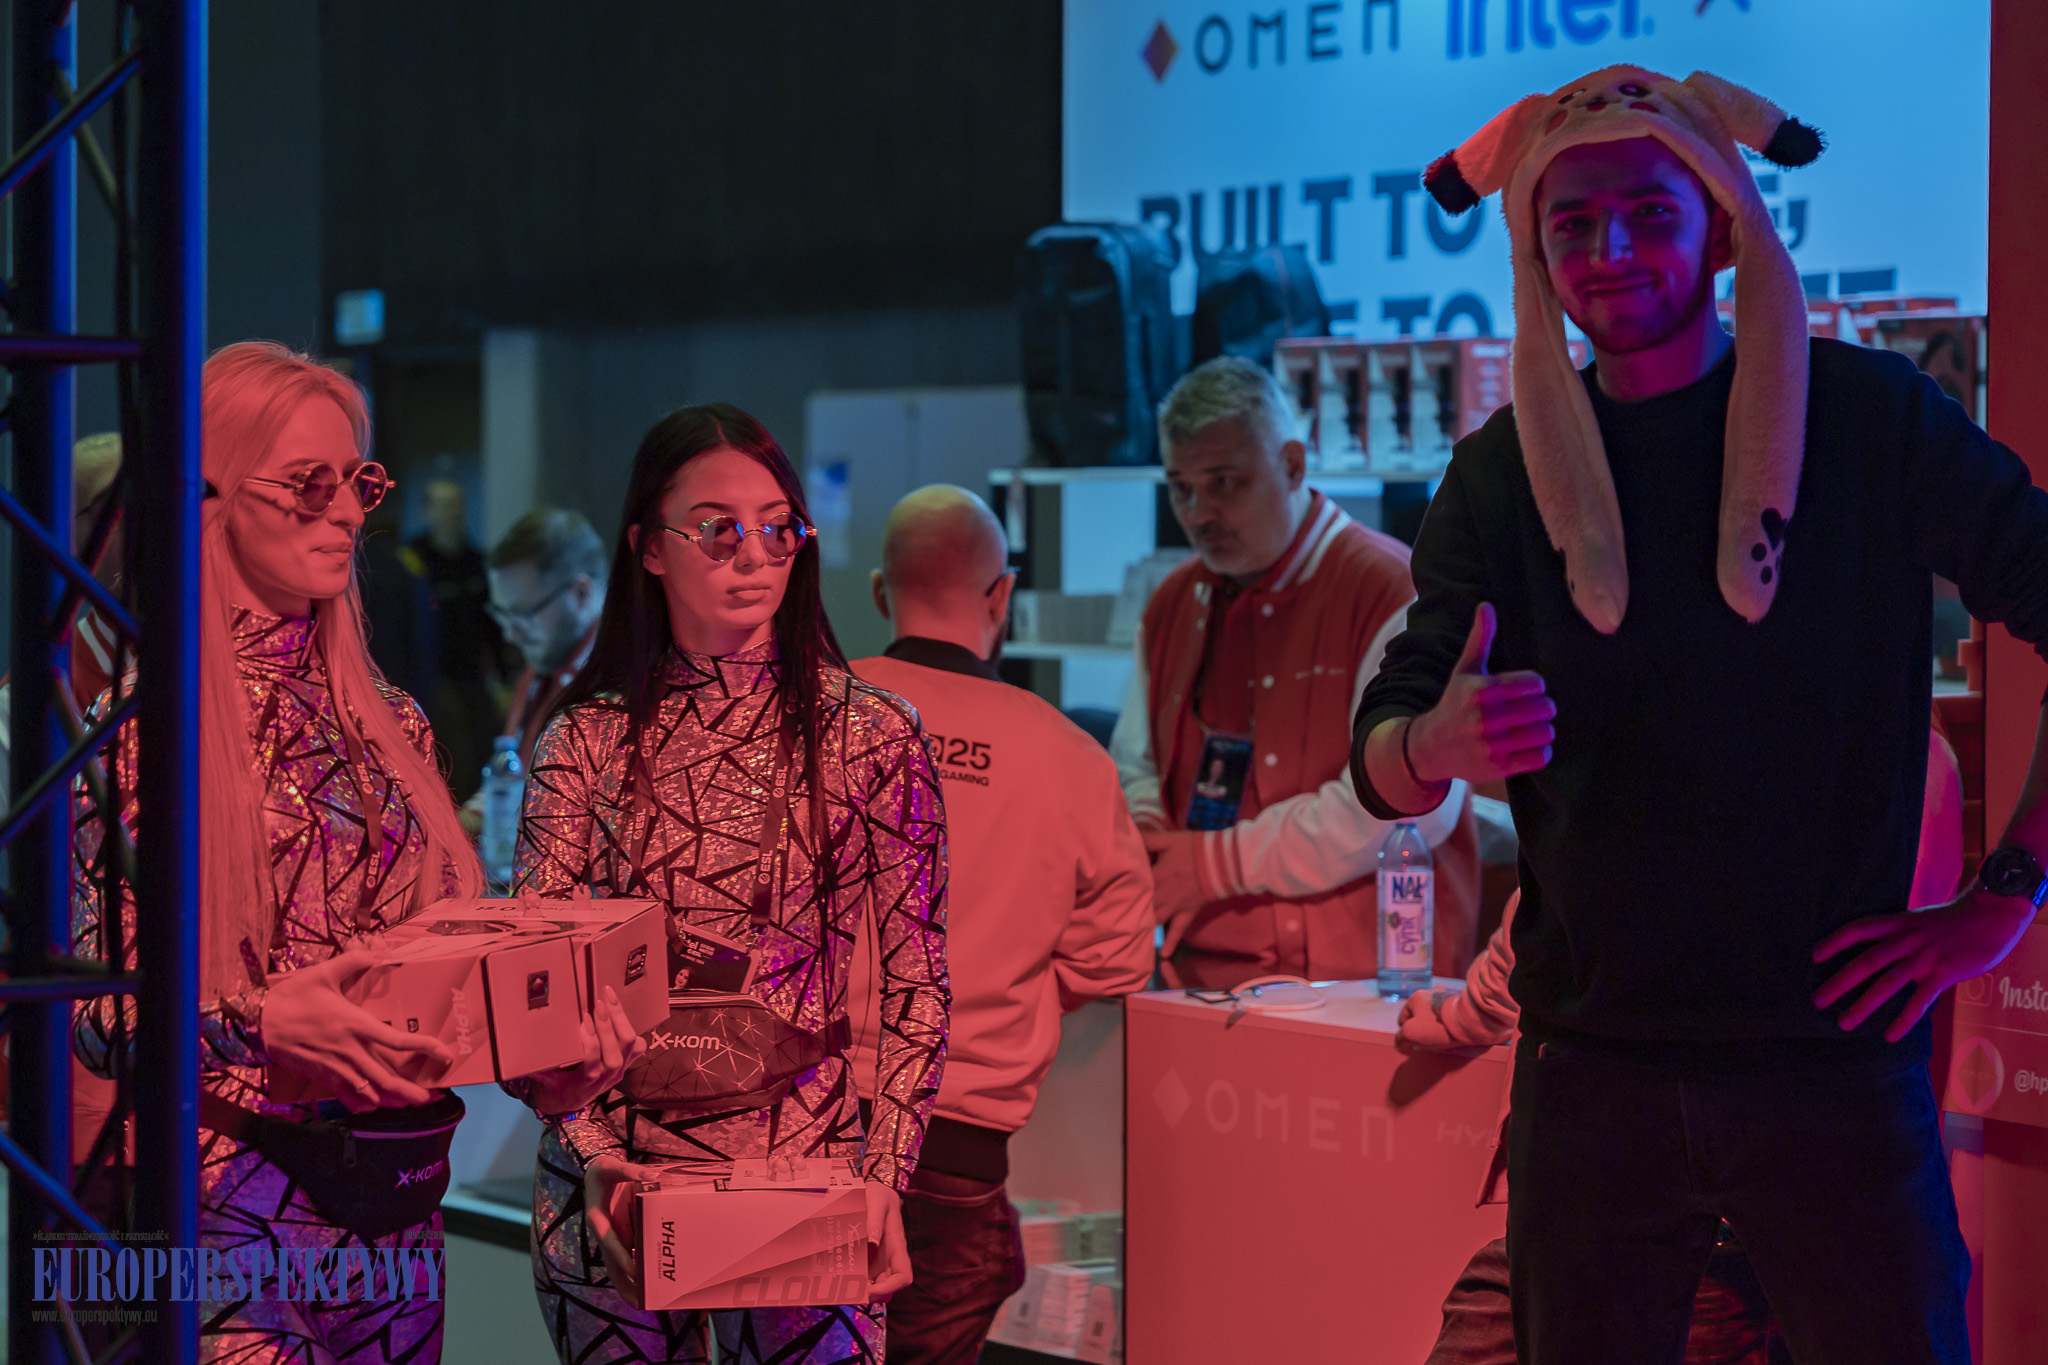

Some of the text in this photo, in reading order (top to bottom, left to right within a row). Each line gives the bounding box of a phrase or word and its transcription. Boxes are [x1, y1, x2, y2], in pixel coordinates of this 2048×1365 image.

[1195, 0, 1399, 73] OMEN
[1141, 172, 1484, 268] BUILT TO
[643, 725, 655, 746] ESL
[946, 738, 991, 770] 25
[775, 766, 788, 787] ESL
[940, 769, 990, 787] GAMING
[635, 808, 647, 829] ESL
[368, 851, 381, 875] ESL
[761, 850, 774, 872] ESL
[451, 987, 473, 1055] ALPHA
[1204, 1078, 1394, 1161] OMEN
[661, 1221, 676, 1282] ALPHA
[733, 1275, 867, 1306] CLOUD
